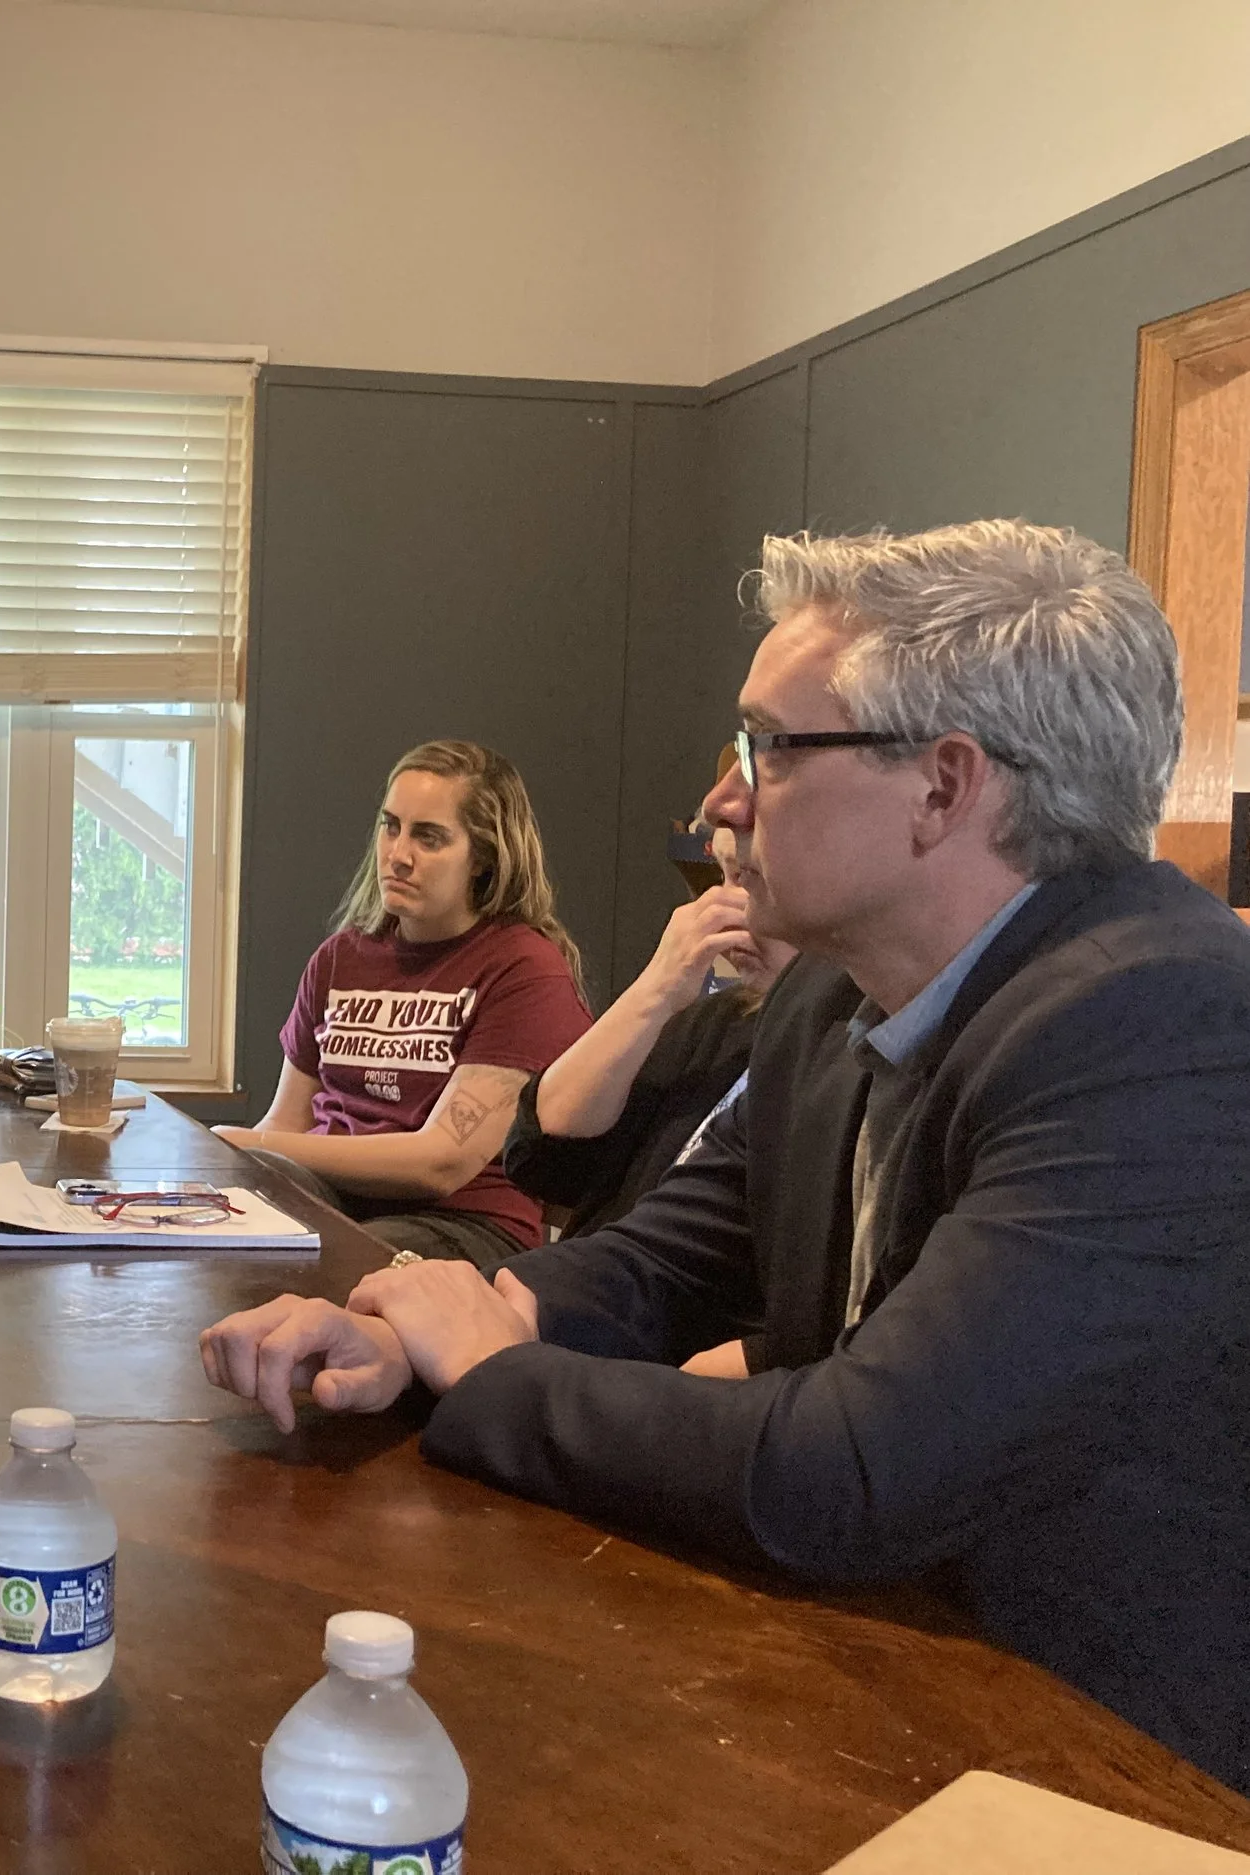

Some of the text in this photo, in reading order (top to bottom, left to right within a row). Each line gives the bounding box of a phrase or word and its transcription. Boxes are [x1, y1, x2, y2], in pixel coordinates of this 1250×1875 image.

[330, 996, 466, 1028] END YOUTH
[364, 1070, 399, 1084] PROJECT
